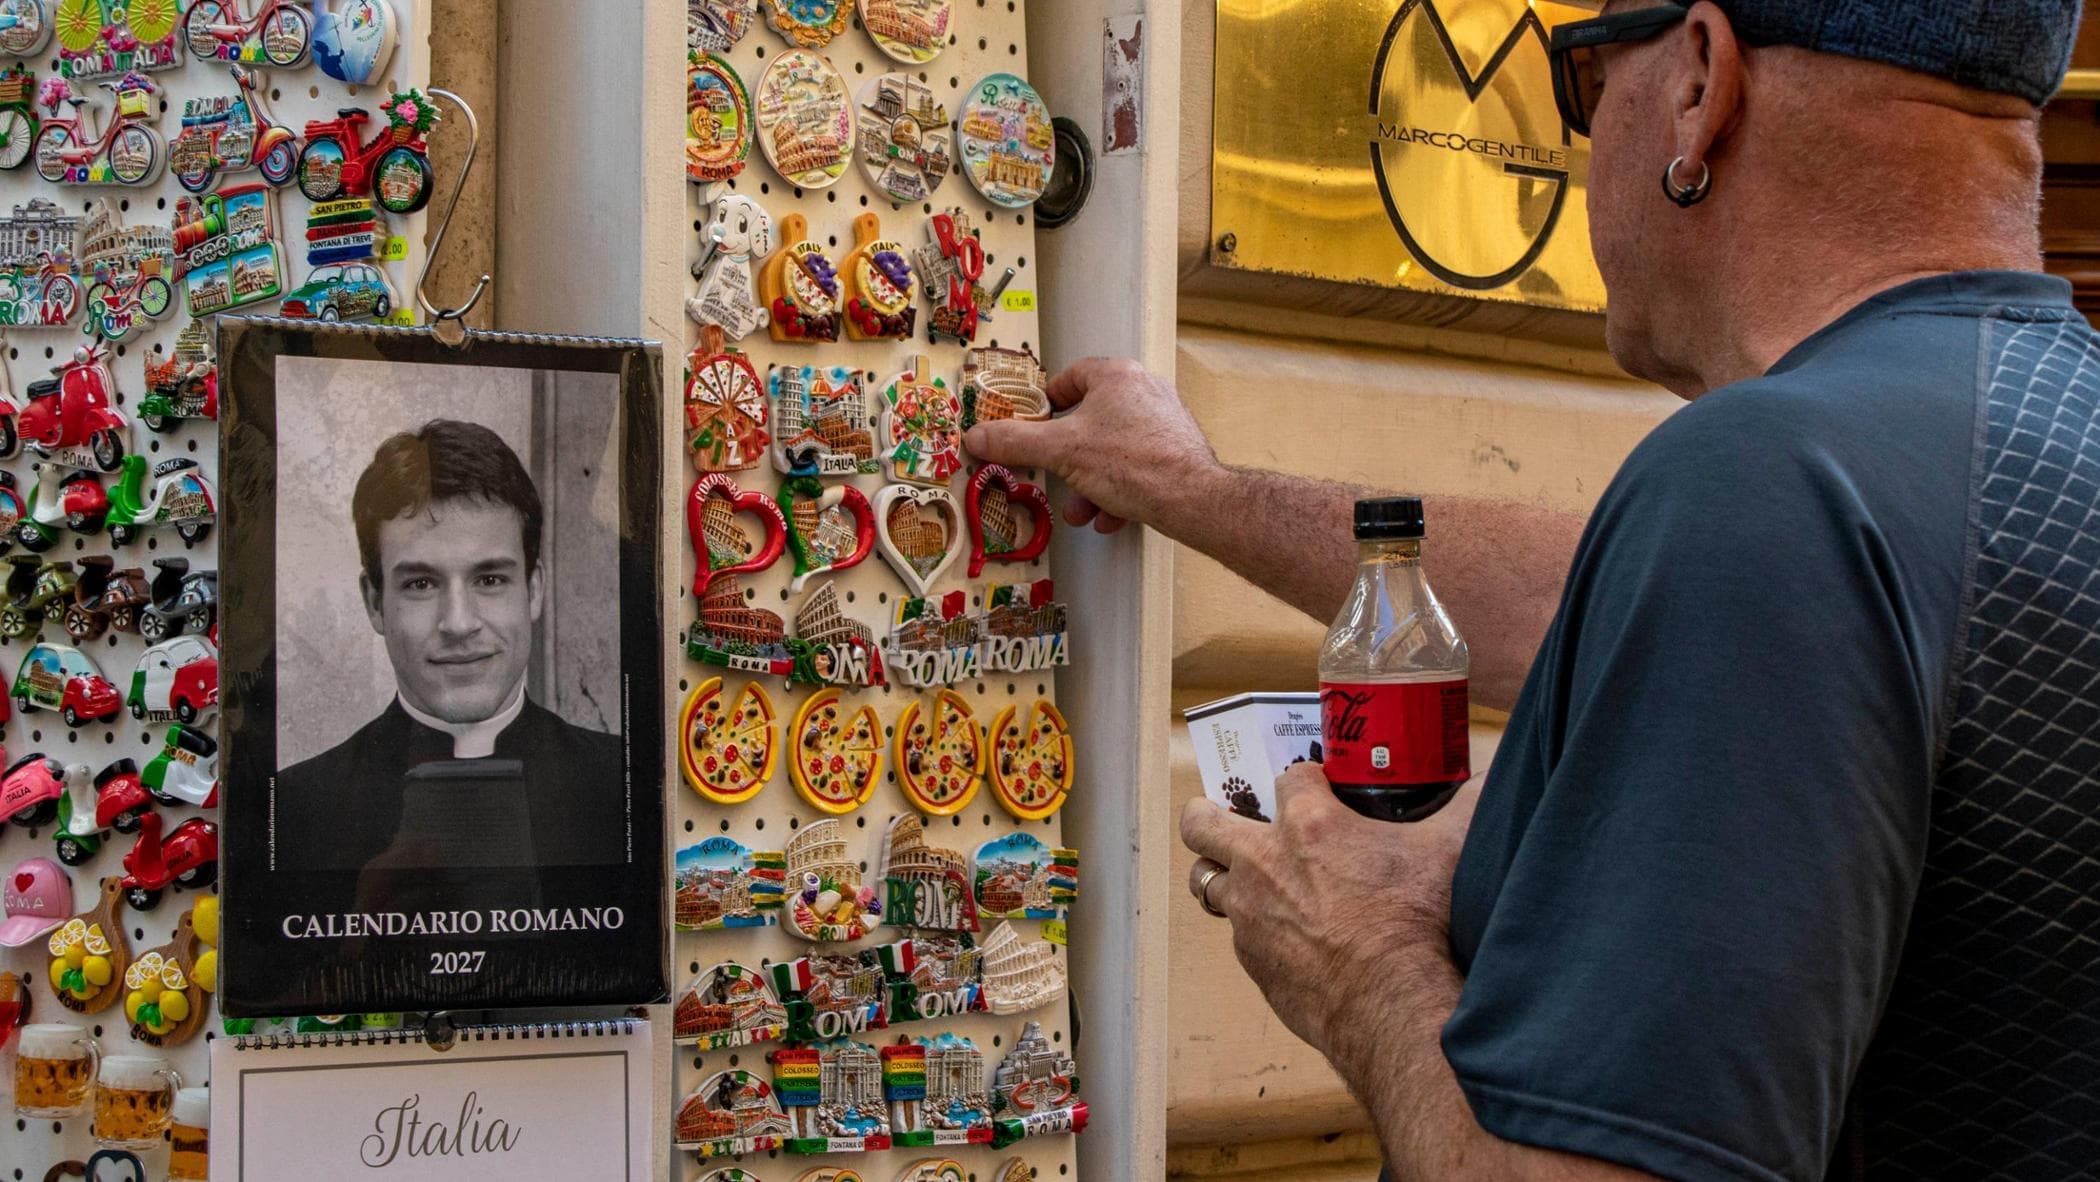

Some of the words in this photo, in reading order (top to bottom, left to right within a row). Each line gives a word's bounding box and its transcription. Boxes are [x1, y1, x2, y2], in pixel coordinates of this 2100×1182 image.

[60, 53, 116, 77] ROMA
[116, 45, 176, 71] ITALIA
[217, 44, 266, 62] ROMA
[184, 96, 229, 117] ROMA
[1378, 123, 1566, 168] MARCOGENTILE
[65, 167, 114, 182] ROMA
[702, 165, 735, 178] ROMA
[315, 204, 332, 215] SAN
[335, 201, 362, 212] PIETRO
[309, 237, 341, 249] FONTANA
[343, 236, 351, 246] DI
[797, 243, 822, 253] ITALY
[870, 240, 895, 252] ITALY
[932, 213, 985, 342] ROMA
[1015, 297, 1031, 306] 1.00
[0, 301, 69, 326] ROMA
[82, 300, 145, 340] Roma
[173, 406, 202, 417] ROMA
[62, 451, 95, 468] ROMA
[823, 458, 857, 472] ITALIA
[891, 440, 962, 478] PIZZA
[154, 461, 180, 477] ROMA
[695, 473, 744, 502] COLOSSEO
[897, 487, 950, 500] ROMA
[759, 493, 788, 531] Roma
[790, 636, 886, 687] ROMA
[982, 632, 1070, 673] ROMA
[731, 657, 769, 672] ROMA
[897, 643, 984, 688] ROMA
[1294, 723, 1322, 737] ESPRESS
[163, 745, 197, 766] ROMA
[6, 786, 32, 803] ITALIA
[702, 838, 740, 856] ROMA
[1009, 833, 1039, 850] ROMA
[883, 869, 981, 932] ROMA
[282, 909, 483, 938] CALENDARIO
[489, 906, 625, 933] ROMANO
[430, 951, 487, 975] 2027
[57, 991, 87, 1012] ROMA
[888, 983, 989, 1023] ROMA
[787, 1001, 889, 1042] ROMA
[130, 1023, 163, 1047] ROMA
[710, 1026, 770, 1050] ITALIA
[783, 1066, 819, 1075] COLOSSEO
[892, 1062, 925, 1070] COLOSSEO
[1027, 1115, 1041, 1124] SAN
[1042, 1110, 1068, 1122] PIETRO
[360, 1091, 522, 1168] Italia
[1028, 1118, 1072, 1137] ROMA
[831, 1140, 856, 1149] FONTANA
